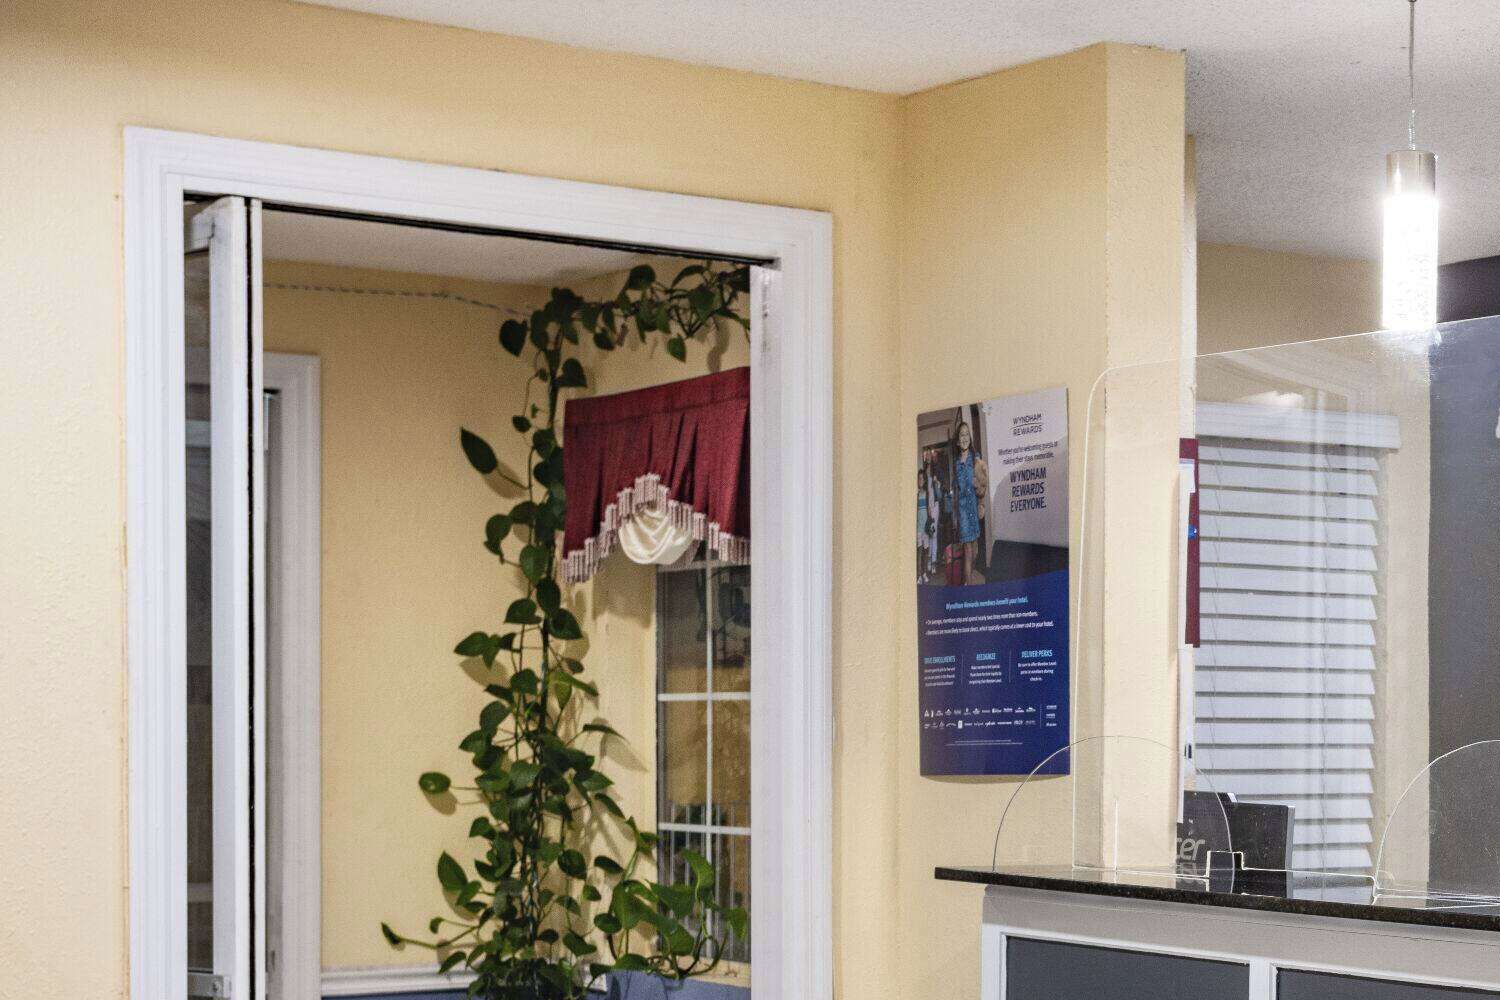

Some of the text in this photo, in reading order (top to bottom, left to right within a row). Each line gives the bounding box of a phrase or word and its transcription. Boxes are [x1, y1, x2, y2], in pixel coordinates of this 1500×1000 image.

[1013, 413, 1042, 425] WYNDHAM
[1013, 425, 1042, 436] REWARDS
[1010, 467, 1047, 482] WYNDHAM
[1011, 482, 1045, 498] REWARDS
[1010, 497, 1047, 513] EVERYONE.
[1177, 837, 1206, 861] er
